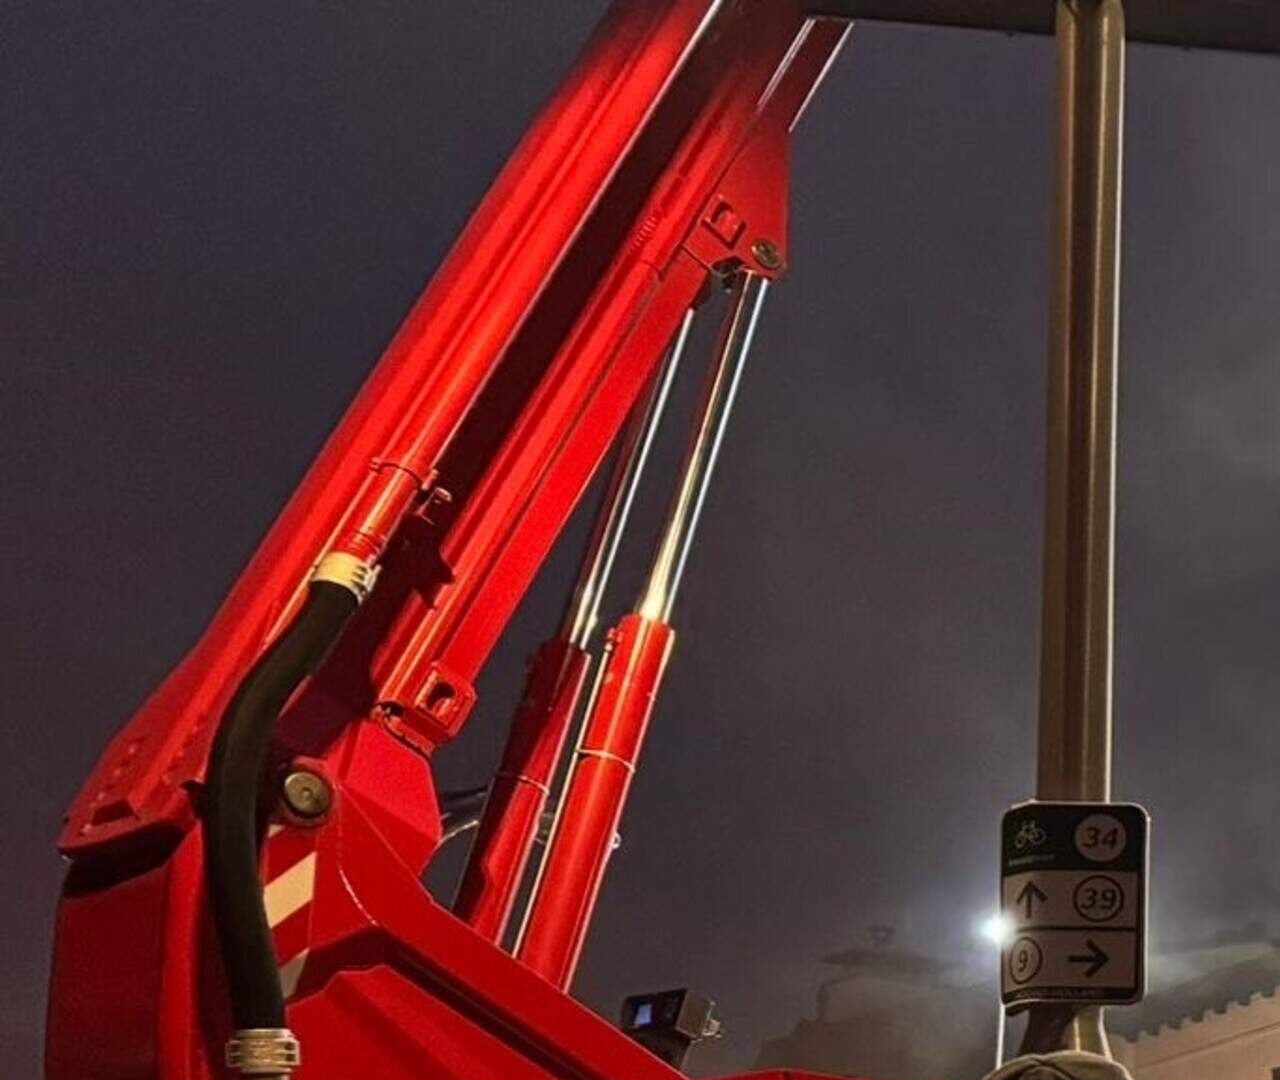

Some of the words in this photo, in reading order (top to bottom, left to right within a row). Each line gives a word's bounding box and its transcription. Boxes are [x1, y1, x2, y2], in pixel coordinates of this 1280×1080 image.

[1082, 826, 1118, 849] 34
[1081, 888, 1117, 910] 39
[1018, 950, 1028, 972] 9
